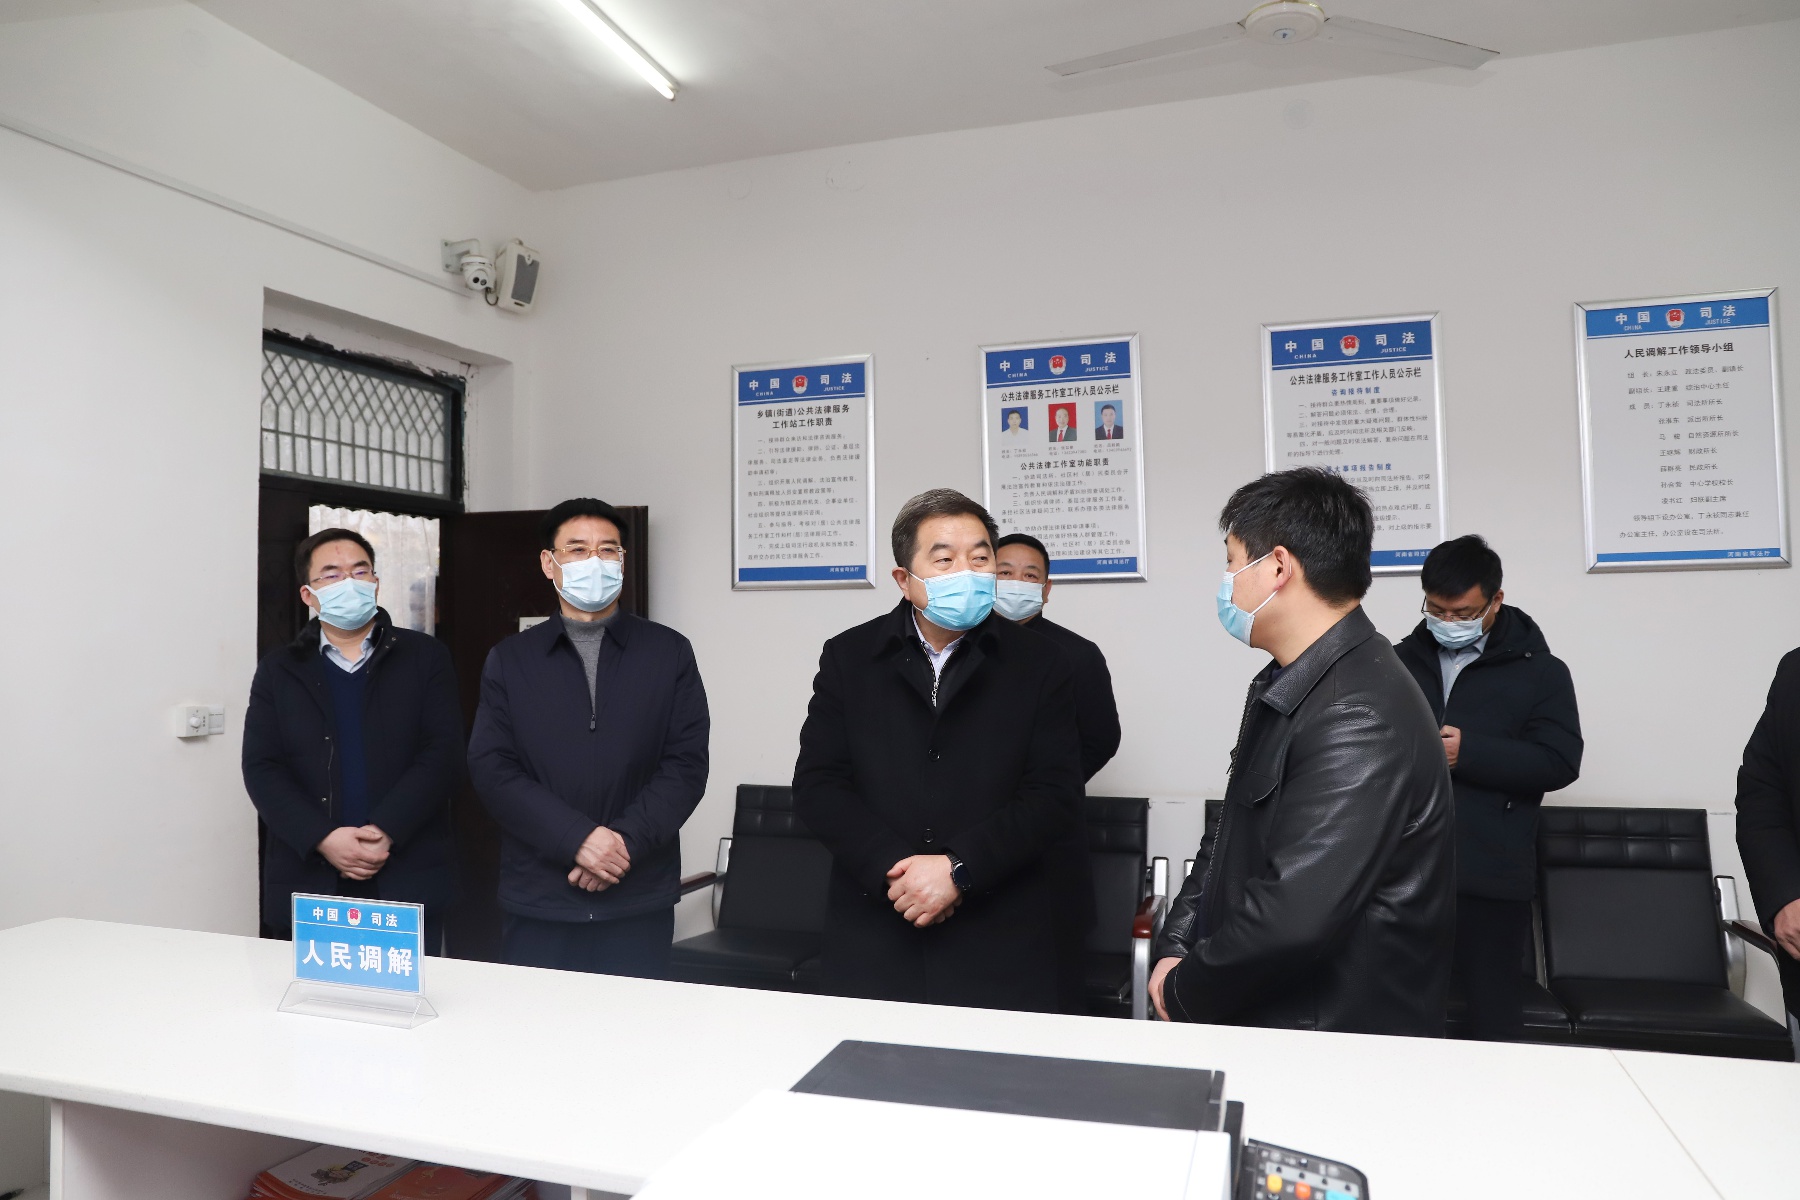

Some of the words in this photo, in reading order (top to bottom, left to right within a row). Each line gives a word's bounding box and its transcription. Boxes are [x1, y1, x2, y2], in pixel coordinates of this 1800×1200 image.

[1615, 312, 1650, 325] 中国
[1700, 305, 1736, 318] 司法
[1285, 338, 1324, 353] 中国
[1375, 332, 1415, 346] 司法
[1624, 342, 1734, 359] 人民调解工作领导小组
[1000, 358, 1034, 372] 中国
[1081, 352, 1116, 365] 司法
[749, 378, 780, 391] 中国
[820, 372, 852, 385] 司法
[1289, 367, 1422, 386] 公共法律服务工作室工作人员公示栏
[1001, 384, 1119, 402] 公共法律服务工作室工作人员公示栏
[1331, 386, 1381, 396] 咨询接待制度
[772, 417, 833, 429] 工作站工作职责
[1020, 458, 1109, 470] 公共法律工作室功能职责
[313, 906, 339, 922] 中国
[371, 912, 398, 927] 司法
[302, 939, 413, 977] 人民调解
